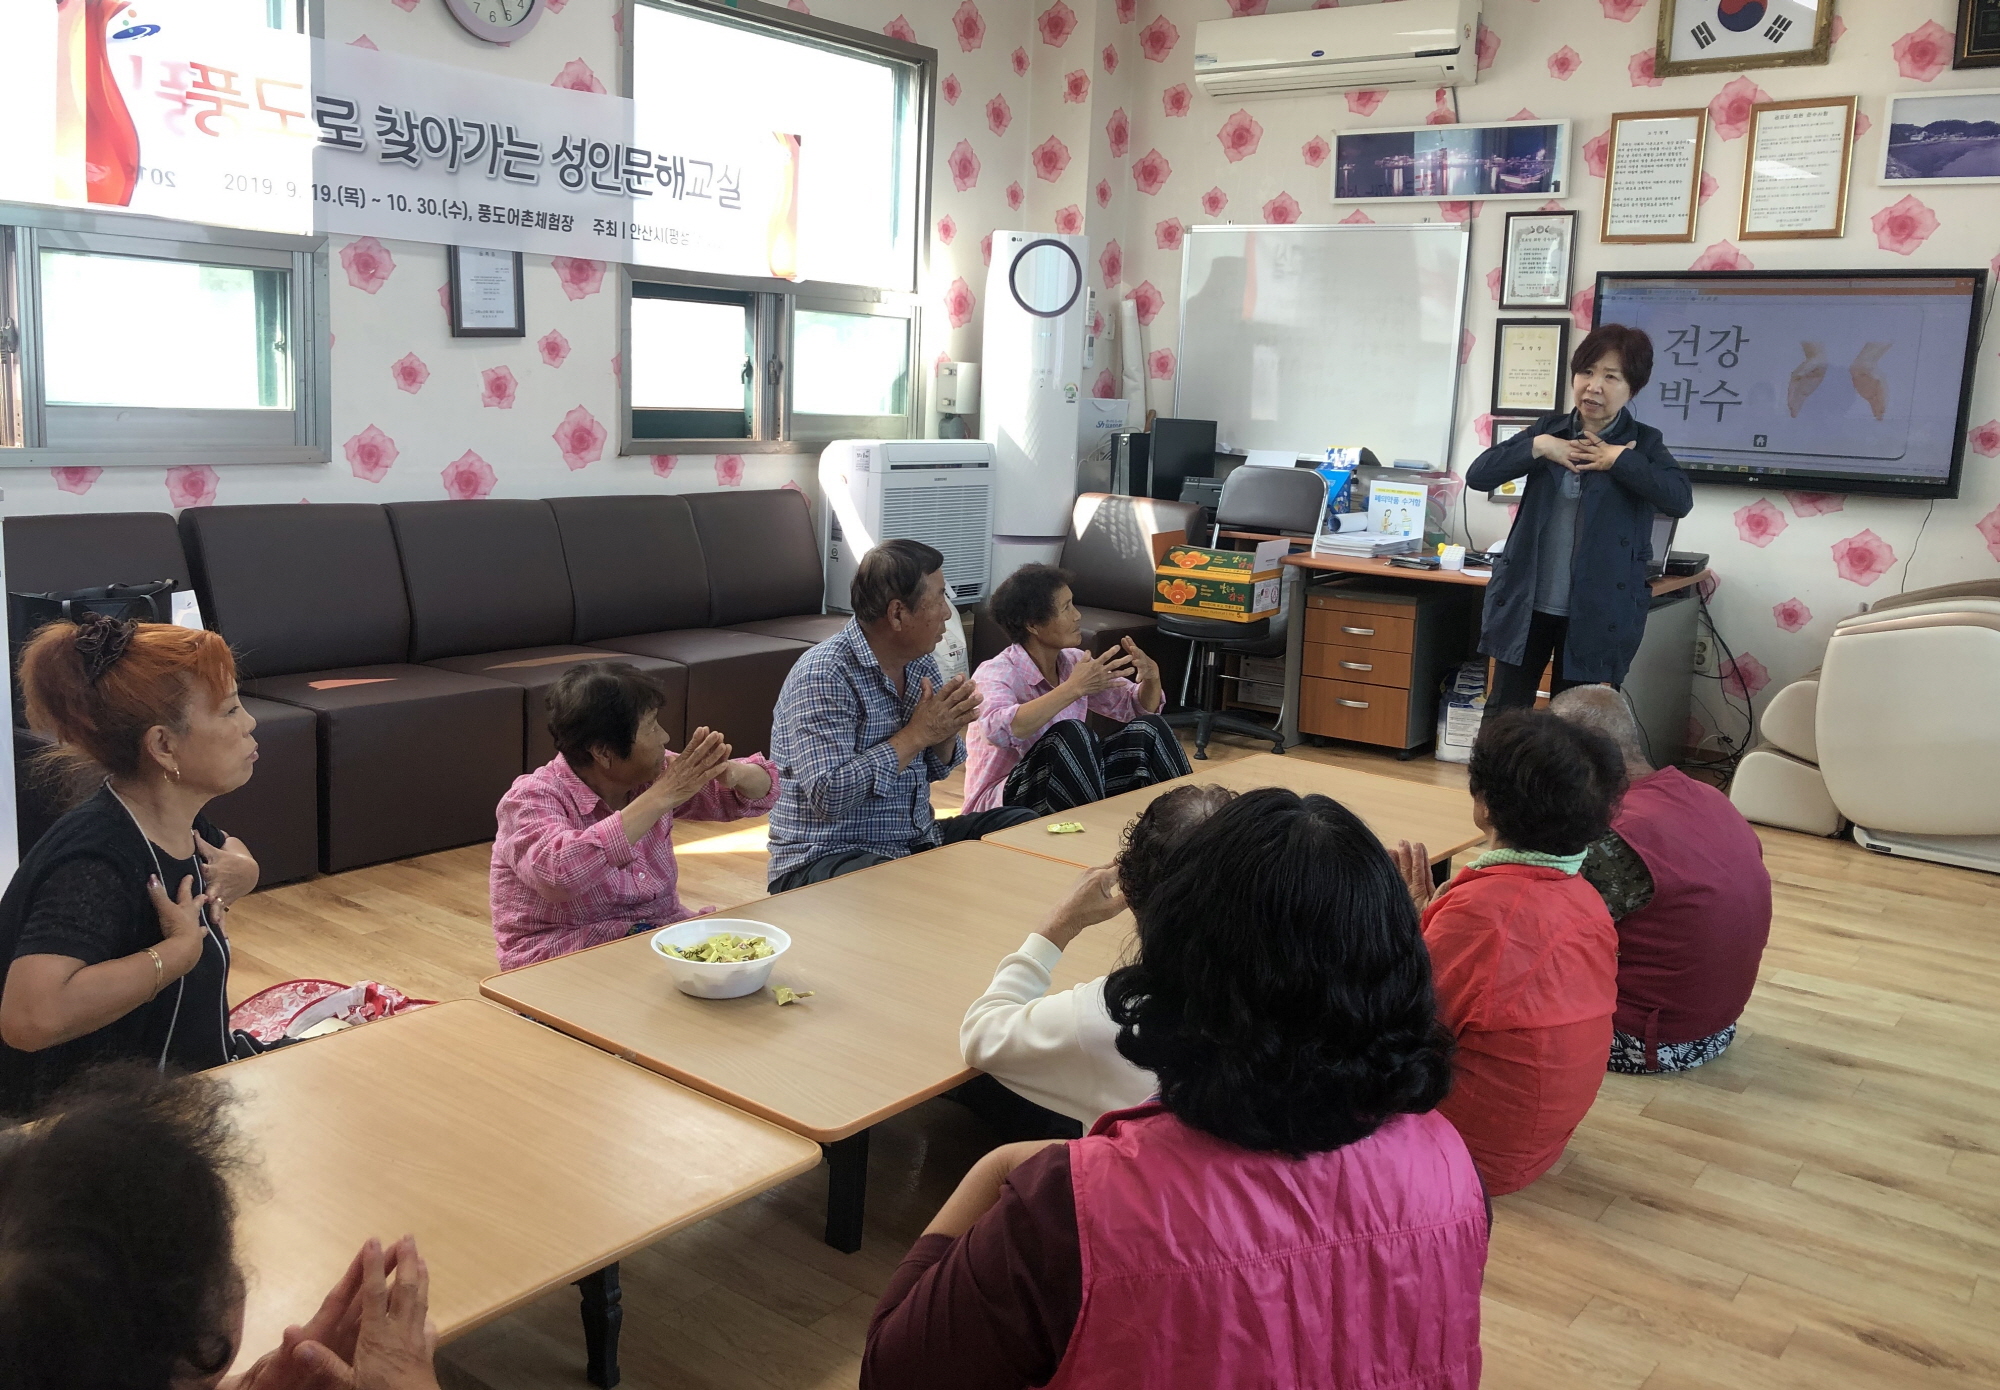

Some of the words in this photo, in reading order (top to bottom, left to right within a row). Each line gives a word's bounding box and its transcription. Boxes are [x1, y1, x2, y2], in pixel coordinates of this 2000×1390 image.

[473, 2, 481, 13] 7
[489, 10, 497, 23] 6
[186, 61, 364, 150] 풍도로
[373, 104, 542, 182] 찾아가는
[551, 134, 741, 211] 성인문해교실
[224, 173, 279, 197] 2019.
[312, 184, 366, 209] 19.(목)
[387, 193, 412, 213] 10.
[417, 196, 473, 222] 30.(수),
[478, 203, 574, 233] 풍도어촌체험장
[592, 217, 618, 238] 주최
[1663, 324, 1750, 368] 건강
[1659, 377, 1743, 422] 박수
[1401, 497, 1422, 508] 수거함
